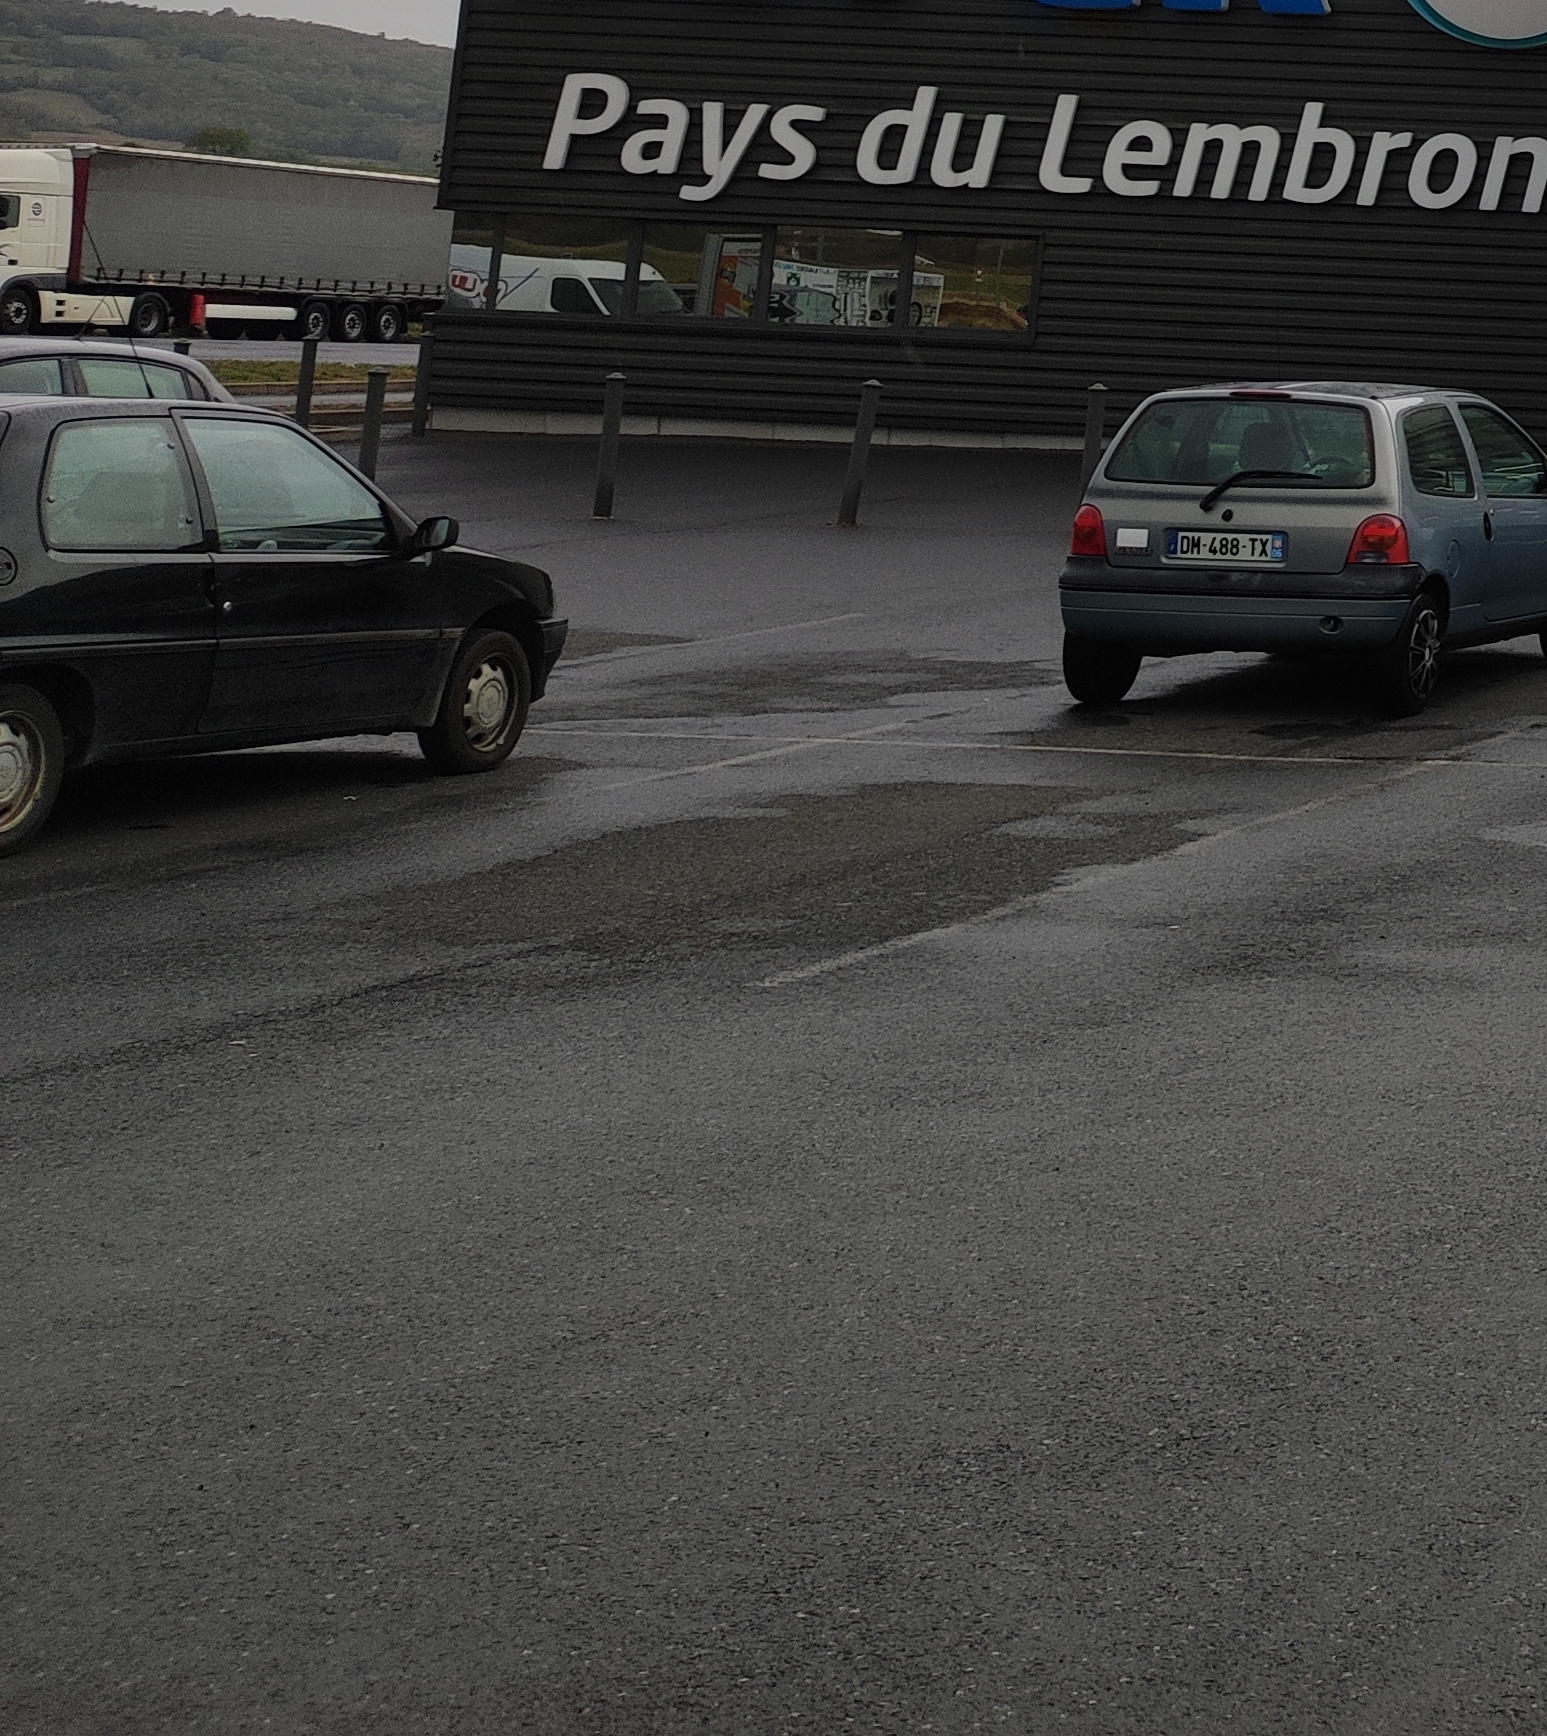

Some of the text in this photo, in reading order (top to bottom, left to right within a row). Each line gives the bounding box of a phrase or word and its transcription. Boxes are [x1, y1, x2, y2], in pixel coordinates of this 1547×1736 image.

[541, 71, 827, 204] Pays
[855, 85, 1006, 190] du
[1180, 535, 1270, 557] DM-488-TX
